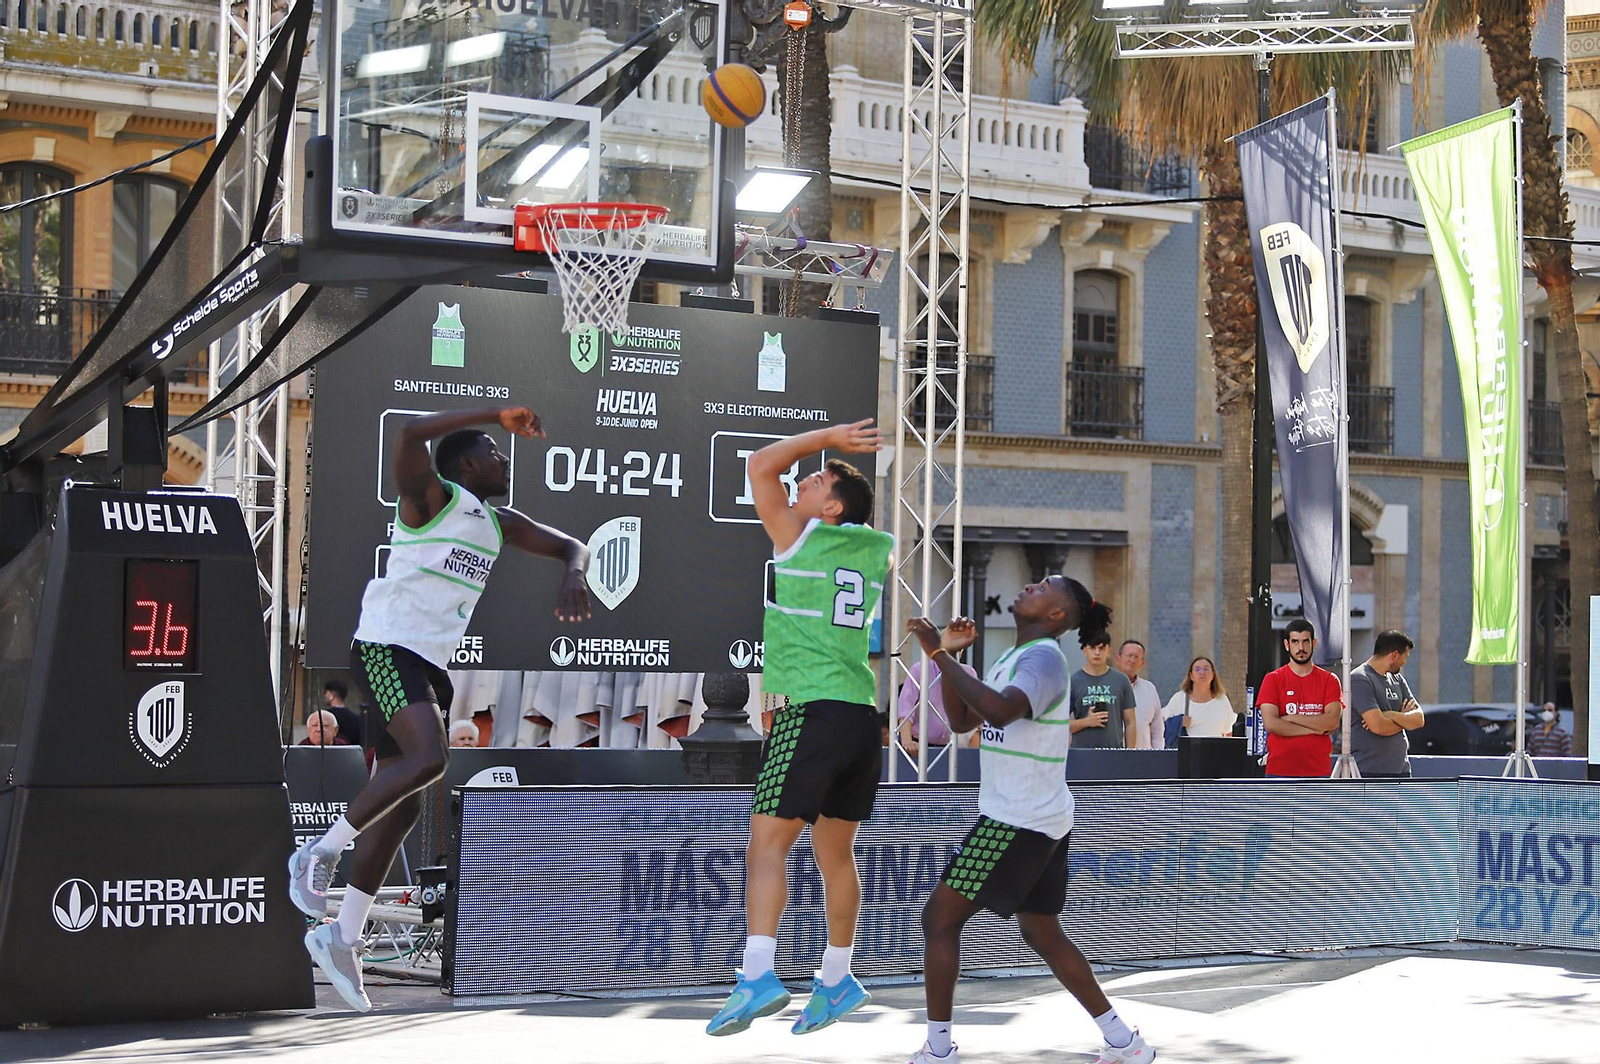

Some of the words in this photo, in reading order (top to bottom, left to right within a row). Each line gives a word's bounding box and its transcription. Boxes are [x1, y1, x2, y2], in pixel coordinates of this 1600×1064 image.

[662, 231, 708, 243] HERBALIFE
[662, 239, 708, 250] NUTRITION
[172, 297, 219, 338] Schelde
[219, 268, 259, 304] Sports
[627, 325, 681, 340] HERBALIFE
[627, 336, 681, 351] NUTRITION
[609, 356, 681, 376] 3X3SERIES
[394, 379, 484, 397] SANTFELIUENC
[486, 386, 510, 399] 3X3
[596, 388, 657, 416] HUELVA
[704, 402, 725, 414] 3X3
[727, 403, 830, 422] ELECTROMERCANTIL
[610, 417, 620, 427] DE
[640, 418, 659, 430] OPEN
[545, 446, 683, 498] 04:24
[101, 501, 218, 534] HUELVA
[619, 522, 637, 532] FEB
[450, 547, 491, 572] HERBAL
[831, 567, 865, 630] 2
[577, 638, 670, 653] HERBALIFE
[451, 650, 483, 664] ION
[577, 652, 670, 667] NUTRITION
[165, 685, 181, 694] FEB
[1087, 685, 1111, 695] MAX
[492, 772, 514, 783] FEB
[620, 837, 824, 913] MÁSTR
[102, 877, 265, 903] HERBALIFE
[102, 902, 265, 928] NUTRITION
[1474, 884, 1523, 931] 28
[1535, 888, 1560, 934] Y
[1572, 890, 1600, 937] 2
[615, 916, 673, 971] 28
[687, 914, 714, 968] Y
